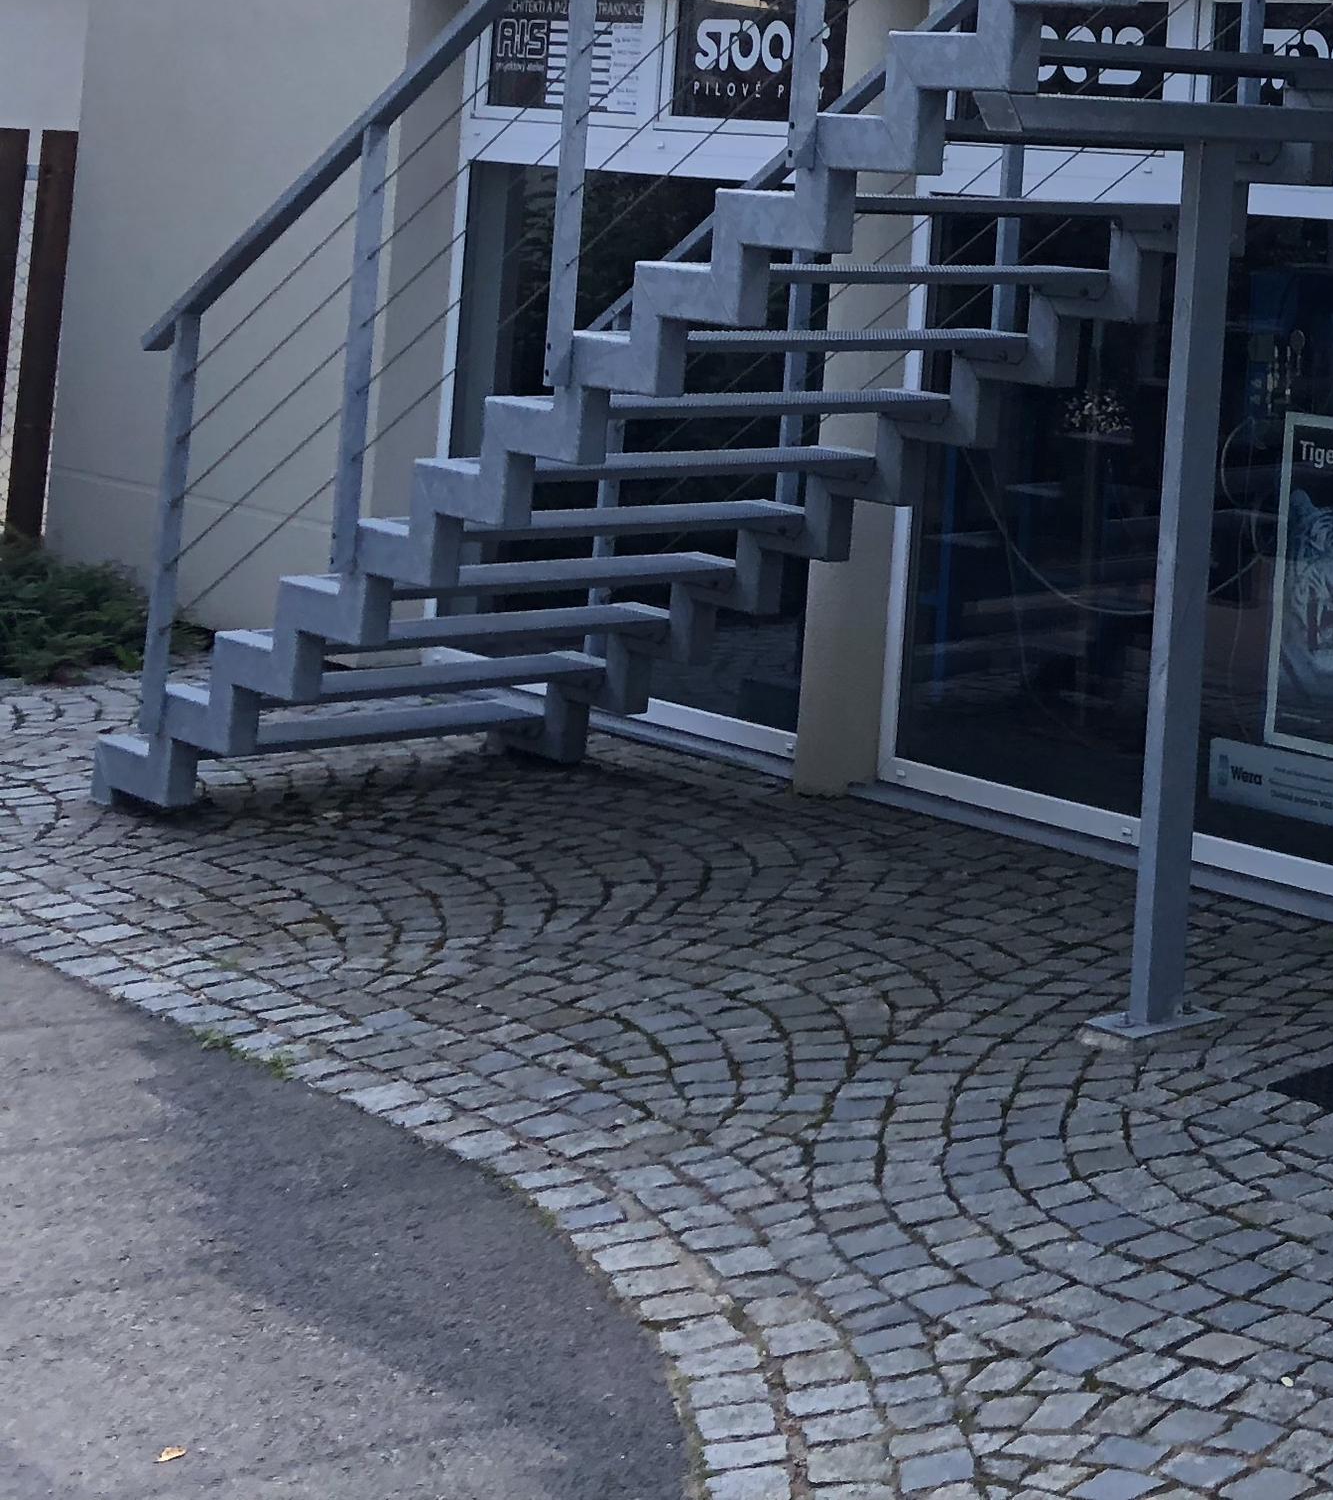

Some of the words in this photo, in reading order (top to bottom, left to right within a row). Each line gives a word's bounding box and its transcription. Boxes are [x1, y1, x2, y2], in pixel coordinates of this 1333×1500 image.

[497, 18, 548, 59] AIS
[693, 81, 762, 99] PILOVÉ
[777, 85, 825, 100] PY
